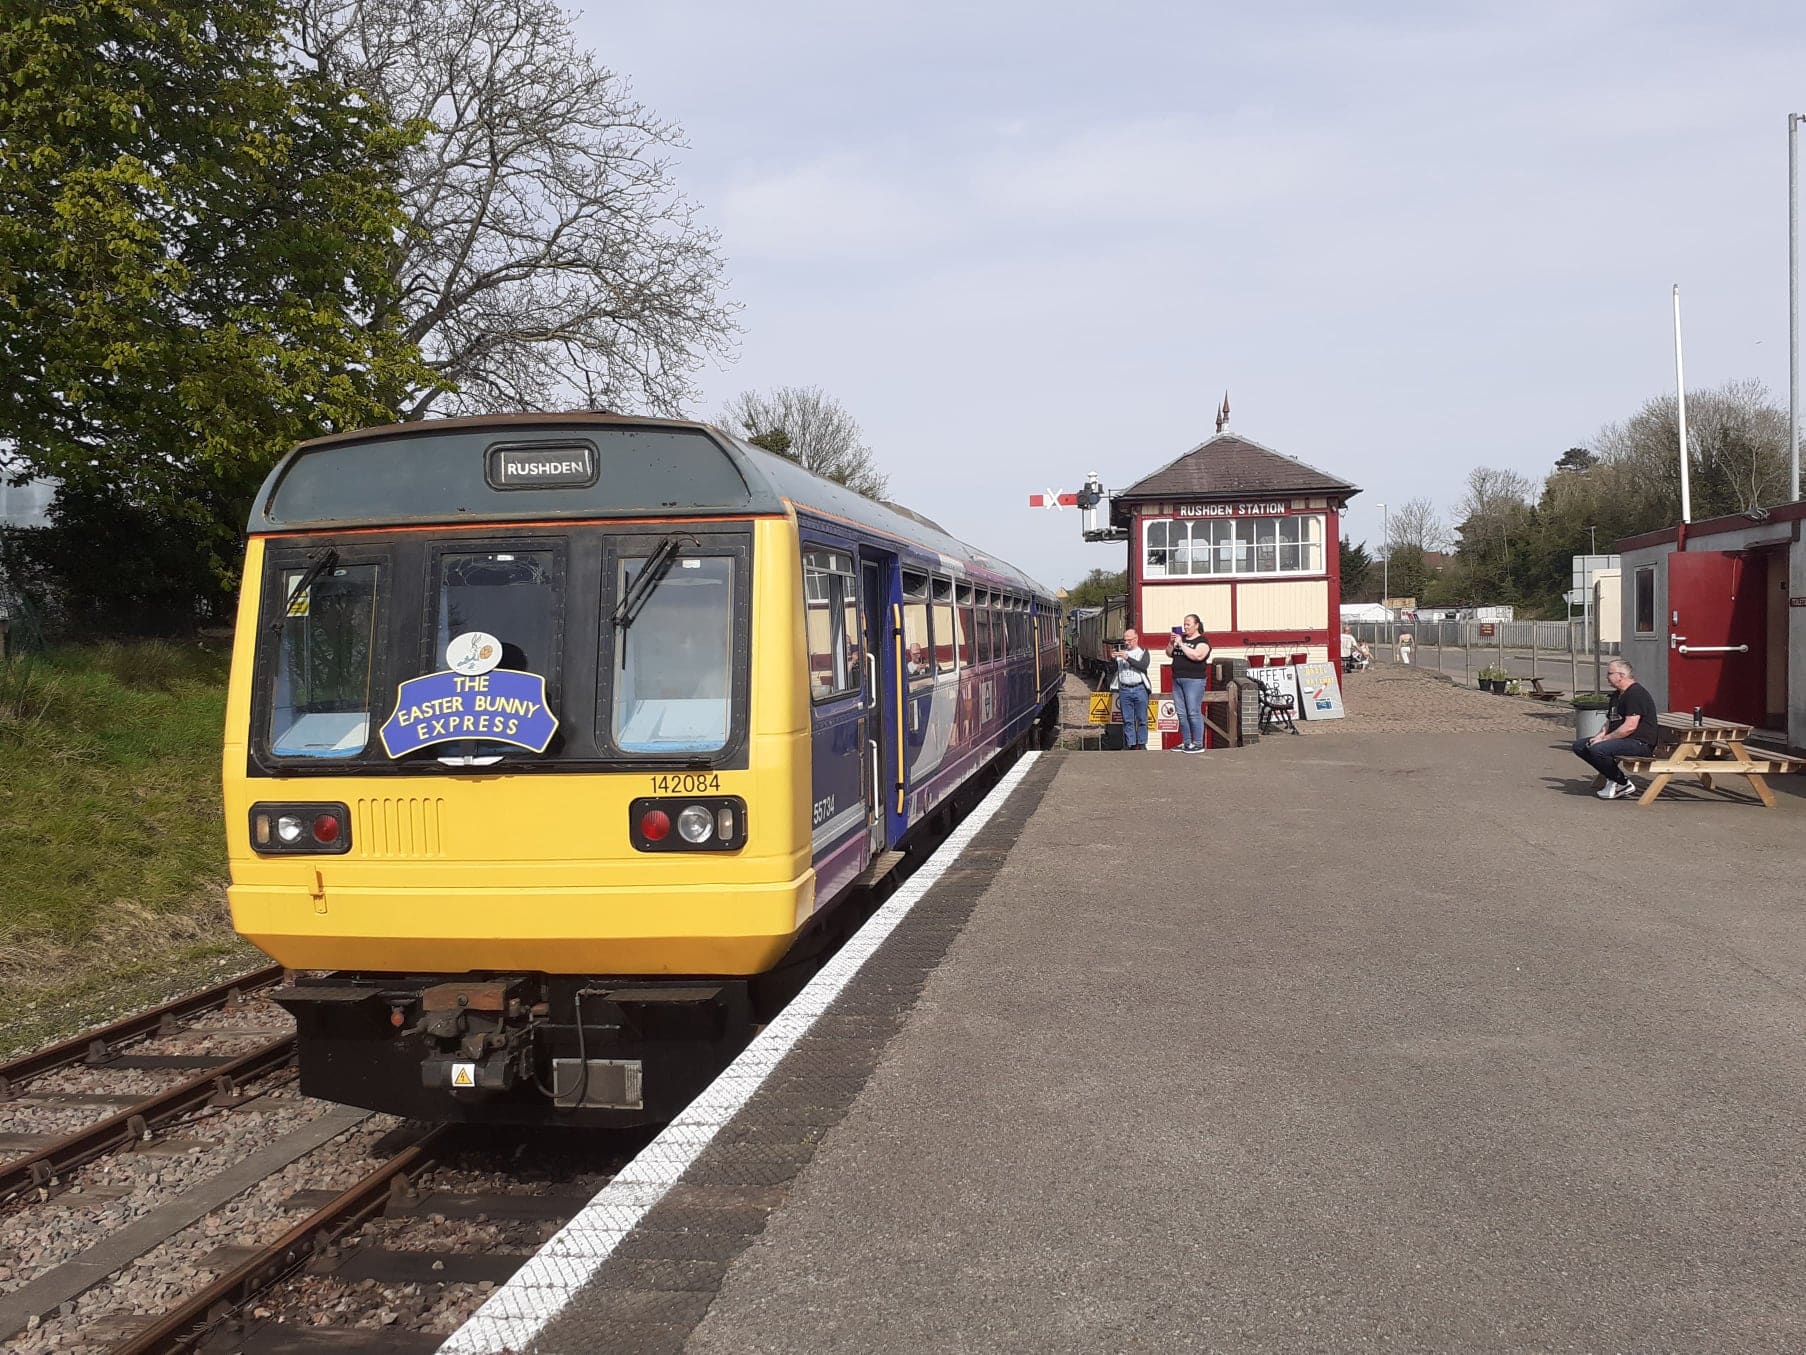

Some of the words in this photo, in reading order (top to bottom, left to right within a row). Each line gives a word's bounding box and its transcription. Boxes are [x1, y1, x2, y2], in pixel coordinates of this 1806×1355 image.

[507, 461, 584, 475] RUSHDEN
[1180, 505, 1233, 516] RUSHDEN
[1238, 503, 1285, 515] STATION
[1247, 667, 1288, 681] UFFET
[453, 676, 490, 692] THE
[397, 696, 464, 727] EASTER
[474, 695, 541, 718] BUNNY
[416, 715, 519, 740] EXPRESS
[649, 774, 721, 793] 142084
[813, 793, 835, 825] 55734
